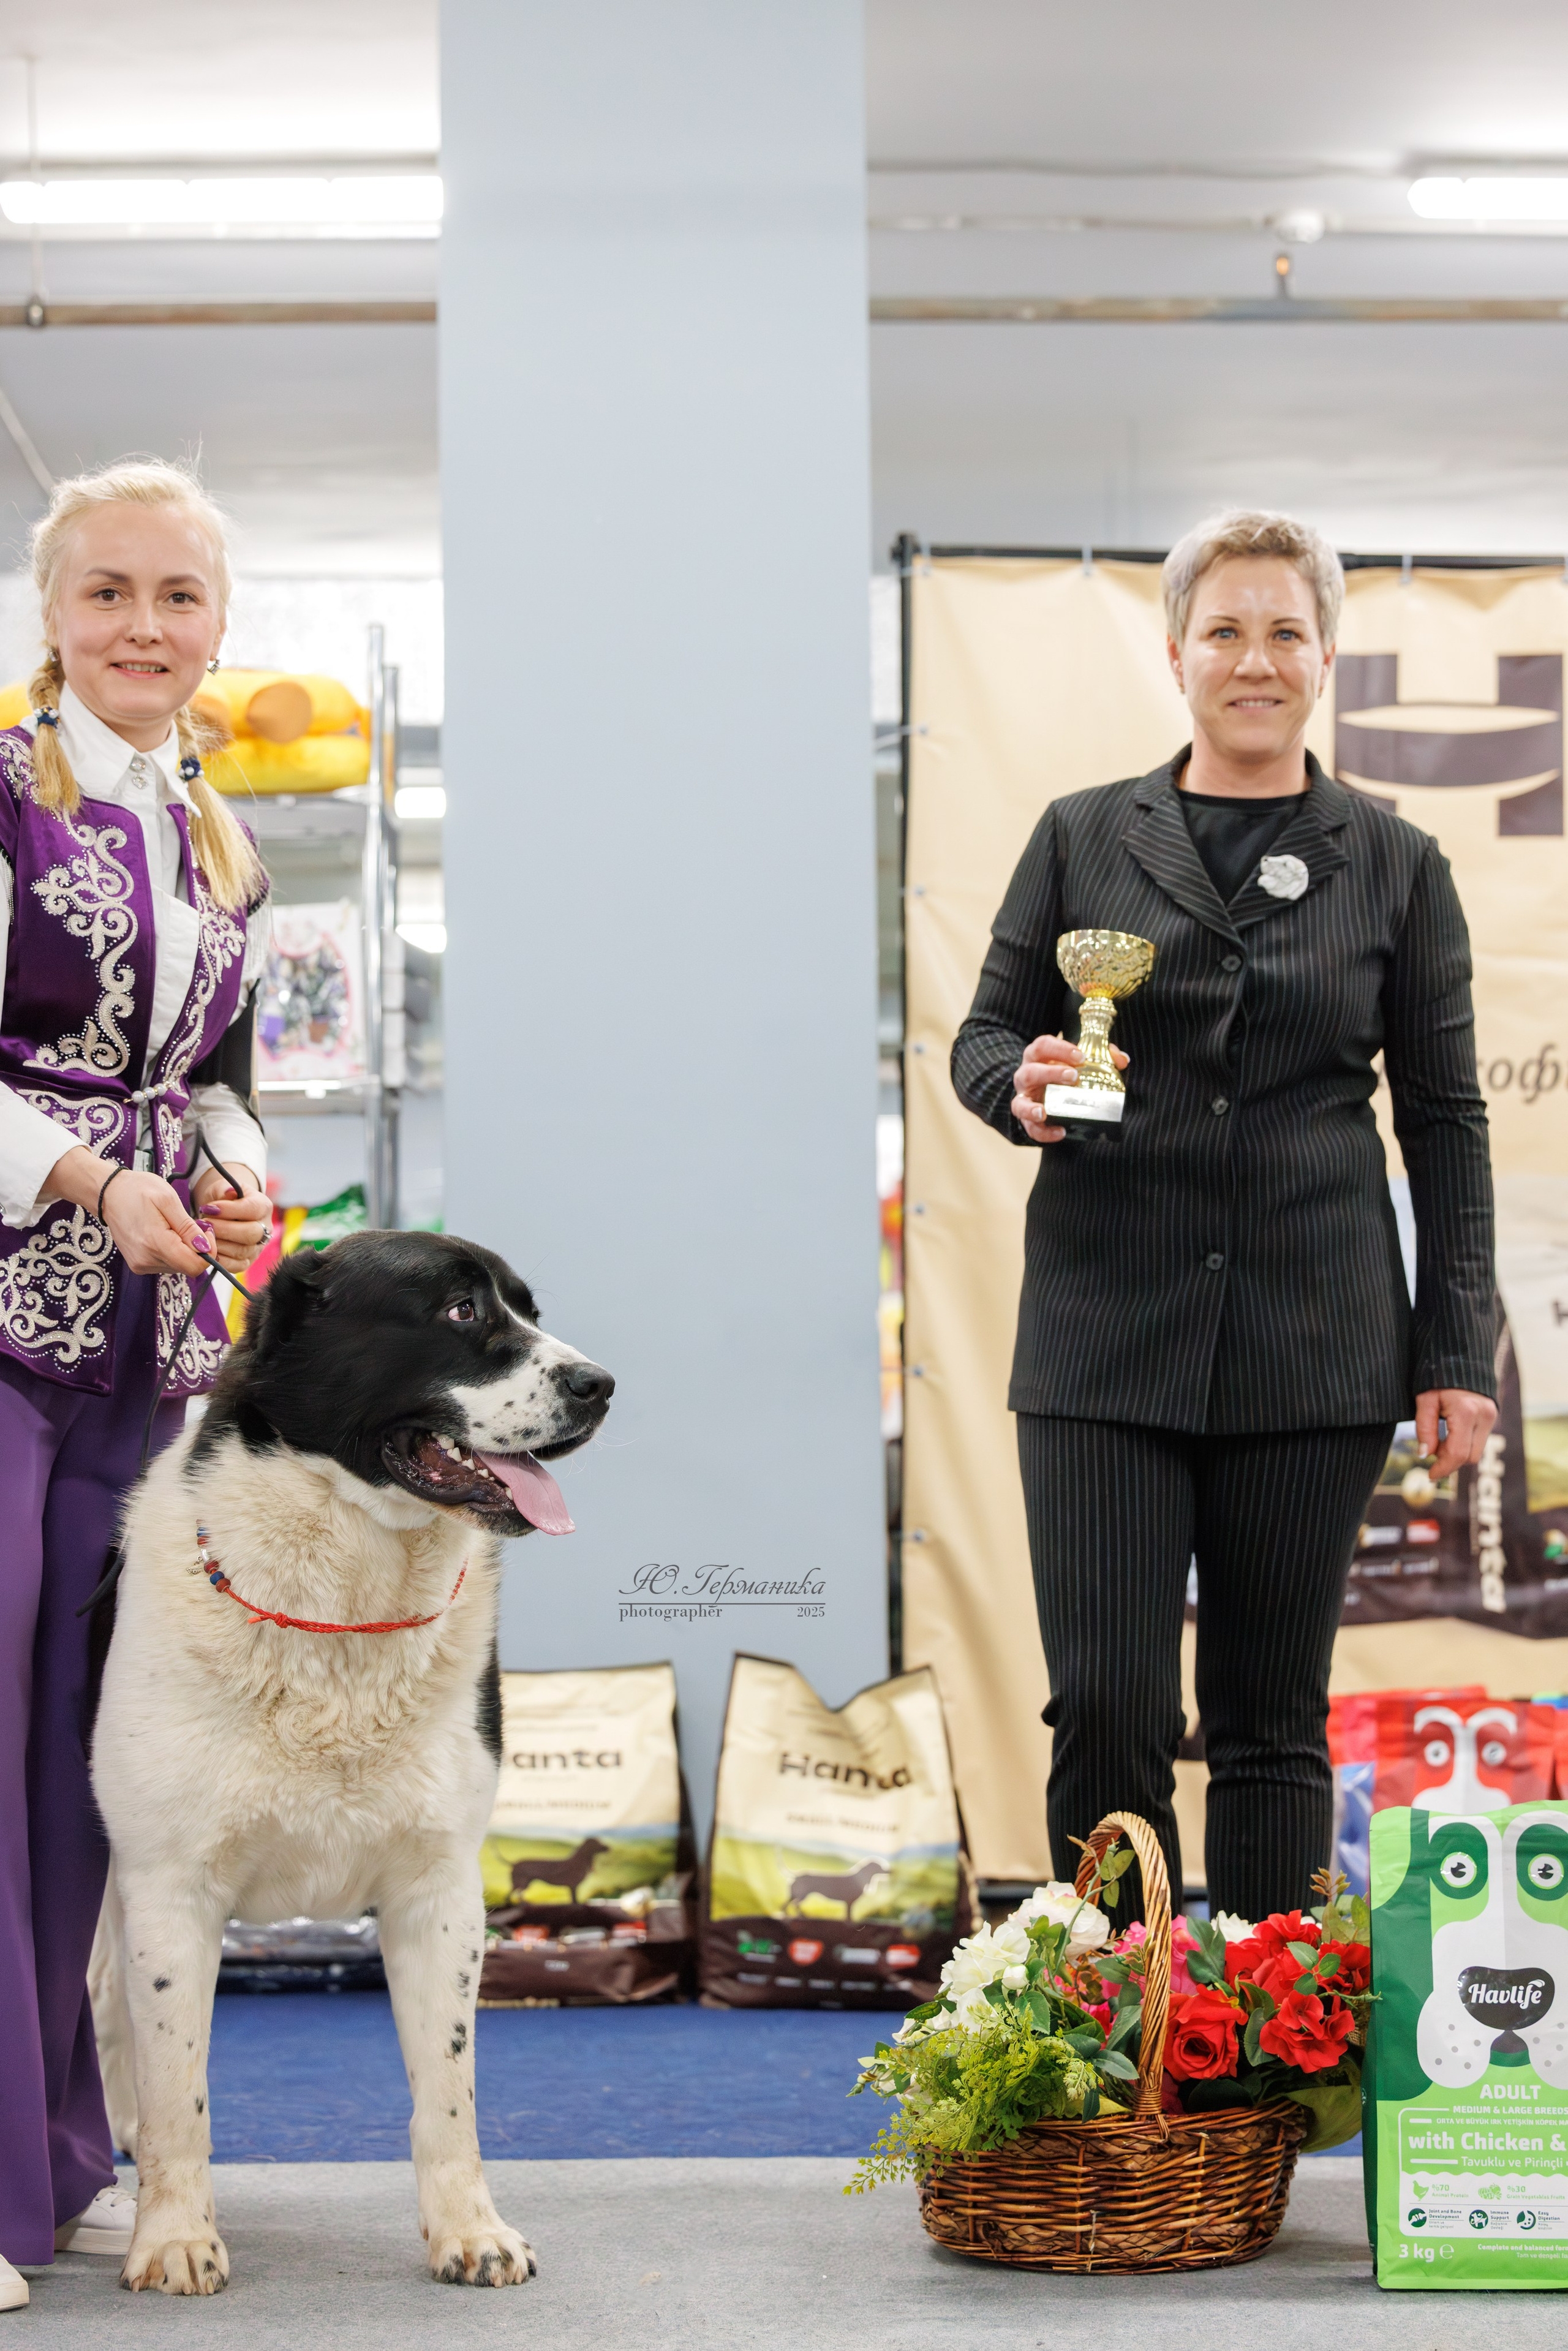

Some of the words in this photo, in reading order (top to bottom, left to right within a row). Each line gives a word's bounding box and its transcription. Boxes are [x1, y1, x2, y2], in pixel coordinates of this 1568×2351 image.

[513, 1748, 622, 1769] anta
[1468, 1979, 1545, 2009] Havlife
[1480, 2084, 1541, 2099] ADULT
[1408, 2131, 1454, 2149] with
[1461, 2132, 1543, 2151] Chicken
[1550, 2134, 1567, 2151] &
[1461, 2156, 1505, 2167] Tavuklu
[1525, 2157, 1563, 2170] Pirinçli
[1399, 2244, 1408, 2258] 3
[1414, 2243, 1434, 2262] kg
